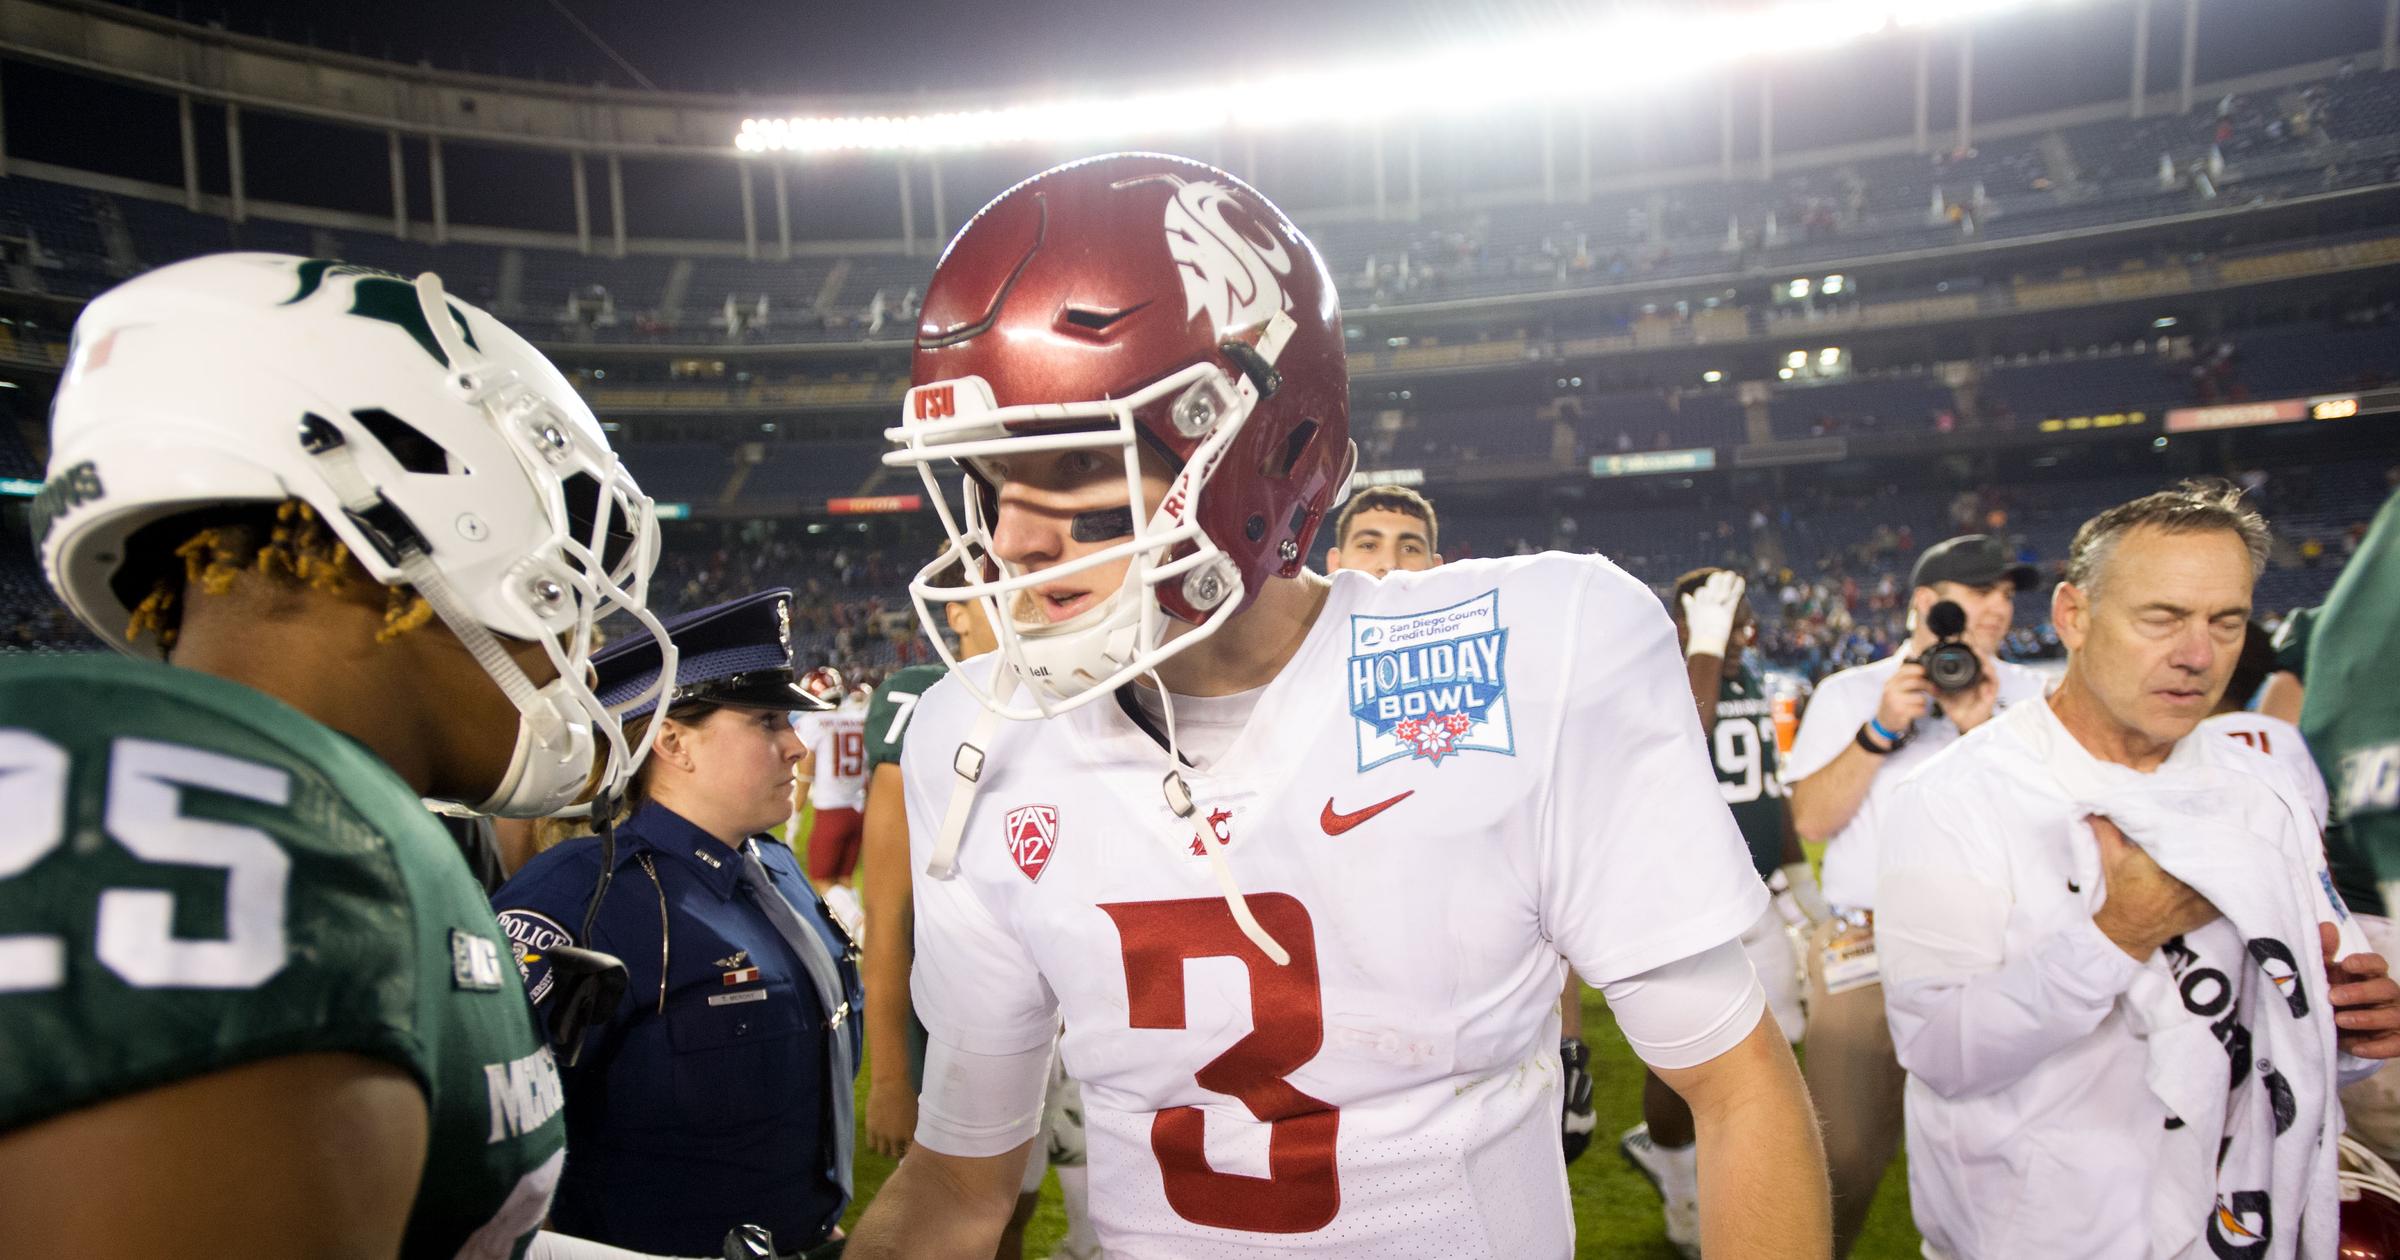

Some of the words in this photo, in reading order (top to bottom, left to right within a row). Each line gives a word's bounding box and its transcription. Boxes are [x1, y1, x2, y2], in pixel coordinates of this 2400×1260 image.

[914, 384, 955, 421] WSU
[1389, 629, 1424, 642] Credit
[1427, 623, 1460, 636] Union
[1390, 623, 1410, 633] San
[1413, 616, 1445, 629] Diego
[1448, 607, 1489, 621] County
[1352, 634, 1501, 707] HOLIDAY
[1379, 683, 1486, 720] BOWL
[832, 731, 863, 777] 19
[1007, 806, 1056, 852] PAC
[1019, 837, 1044, 867] 12
[1096, 891, 1341, 1234] 3
